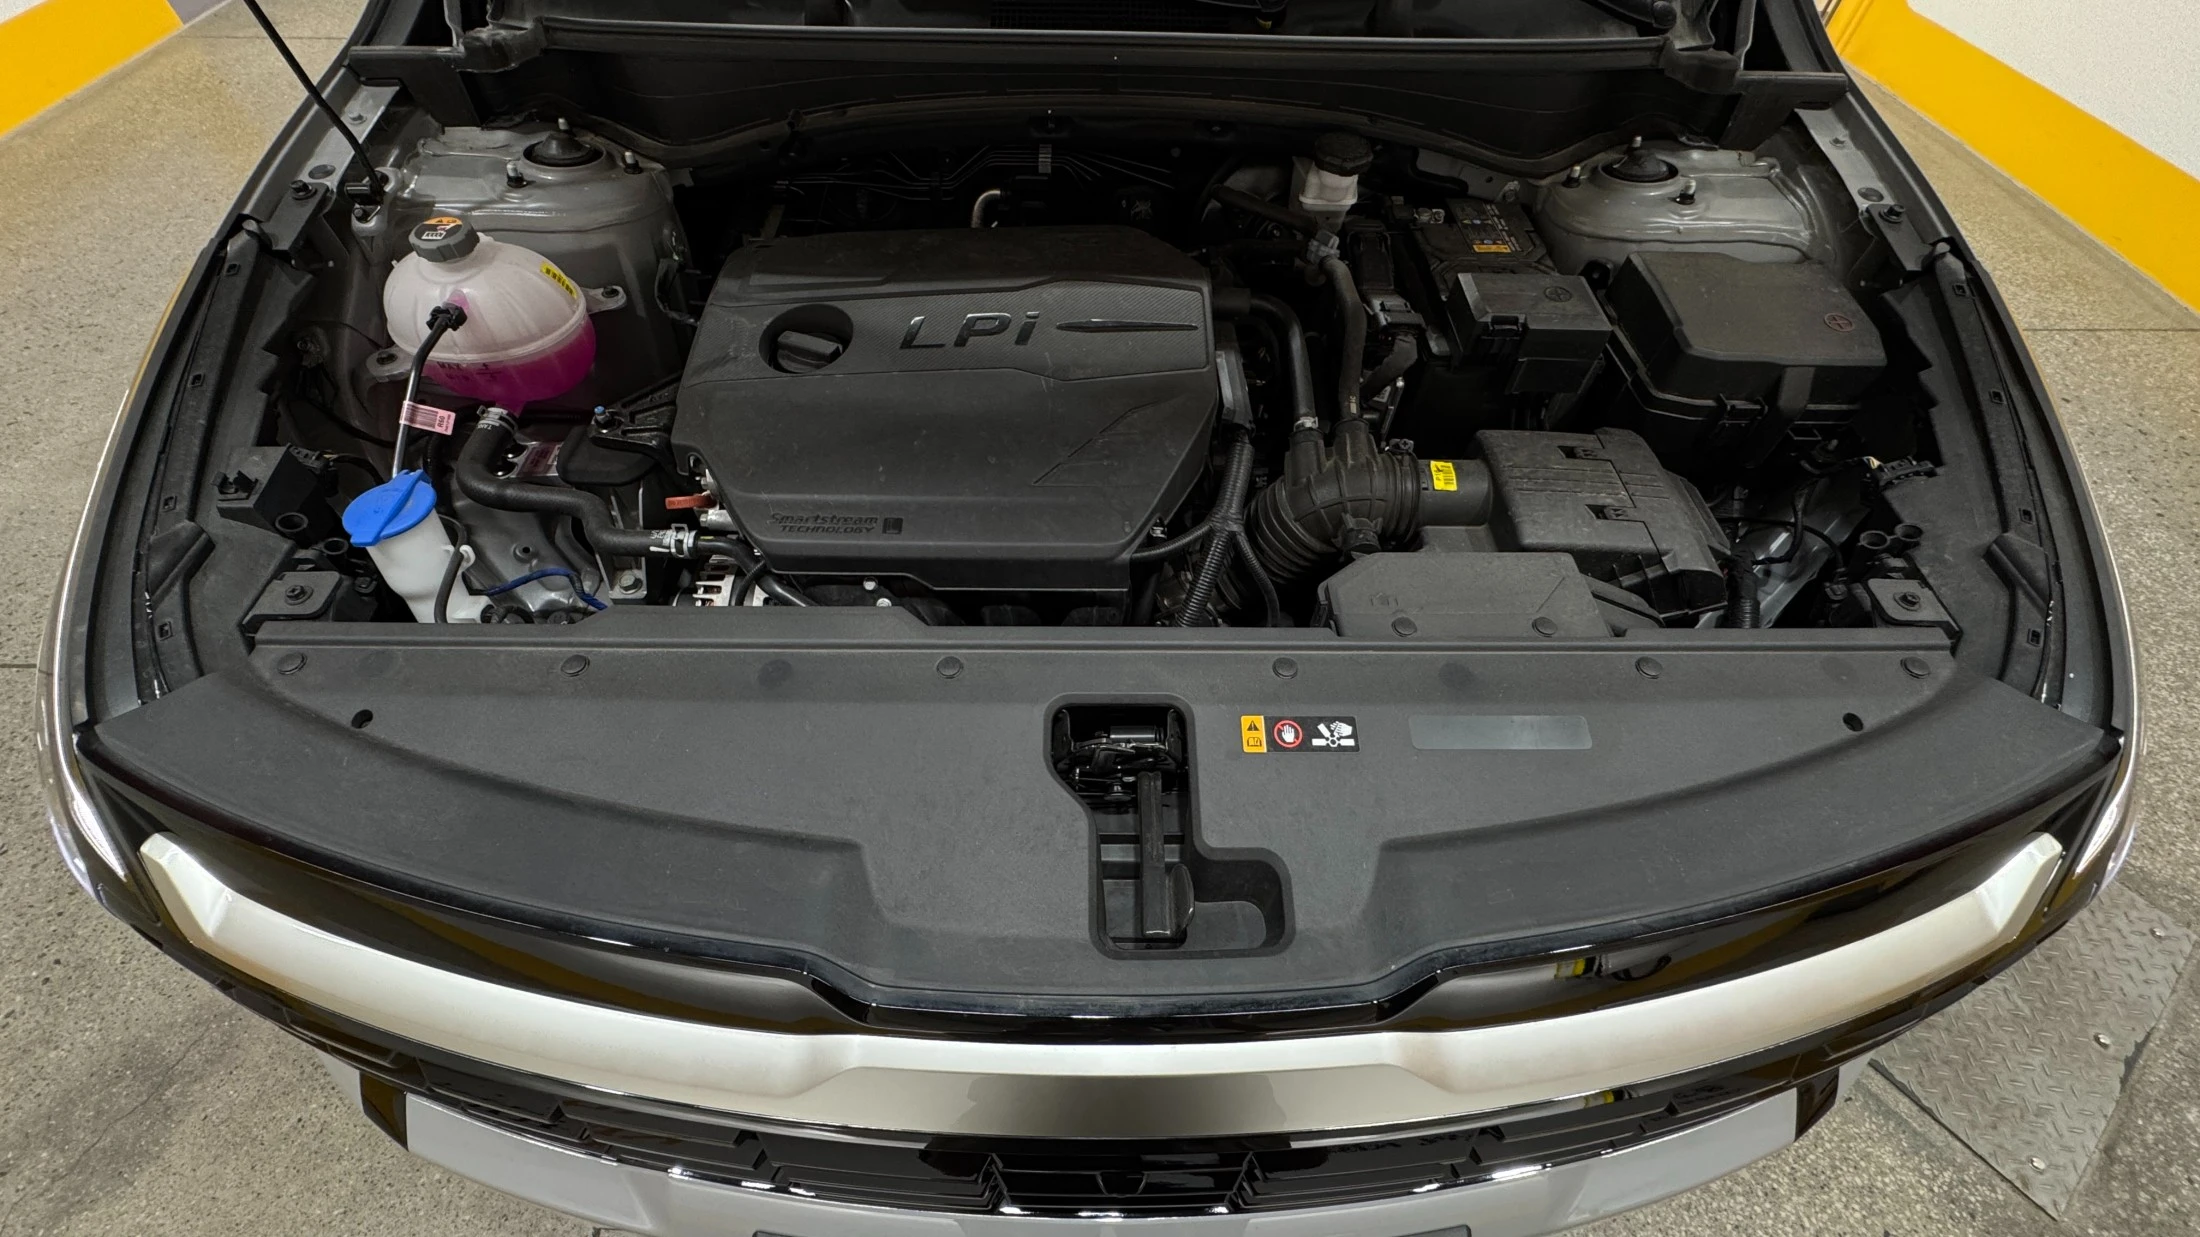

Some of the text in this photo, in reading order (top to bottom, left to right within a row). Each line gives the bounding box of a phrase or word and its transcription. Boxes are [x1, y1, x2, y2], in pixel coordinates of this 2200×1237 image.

[900, 311, 1040, 349] LPi
[772, 512, 878, 524] Smartstream
[781, 525, 875, 534] TECHNOLOGY
